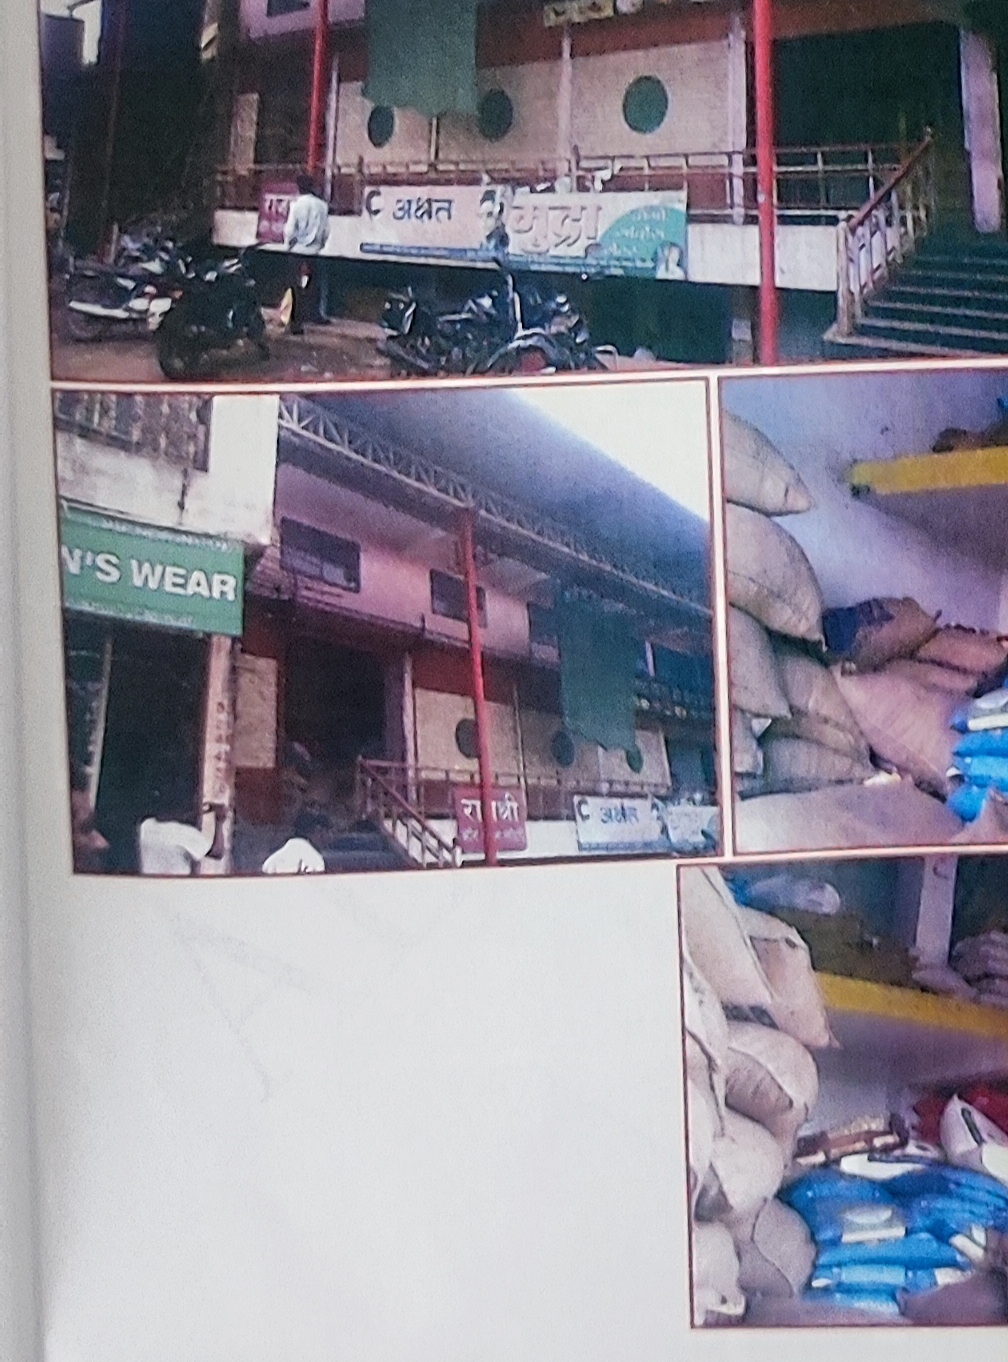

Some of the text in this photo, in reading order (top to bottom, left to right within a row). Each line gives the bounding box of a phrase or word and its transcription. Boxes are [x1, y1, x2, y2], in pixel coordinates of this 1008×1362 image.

[391, 195, 454, 225] अक्षत
[130, 559, 238, 602] WEAR
[460, 792, 520, 822] राश्री
